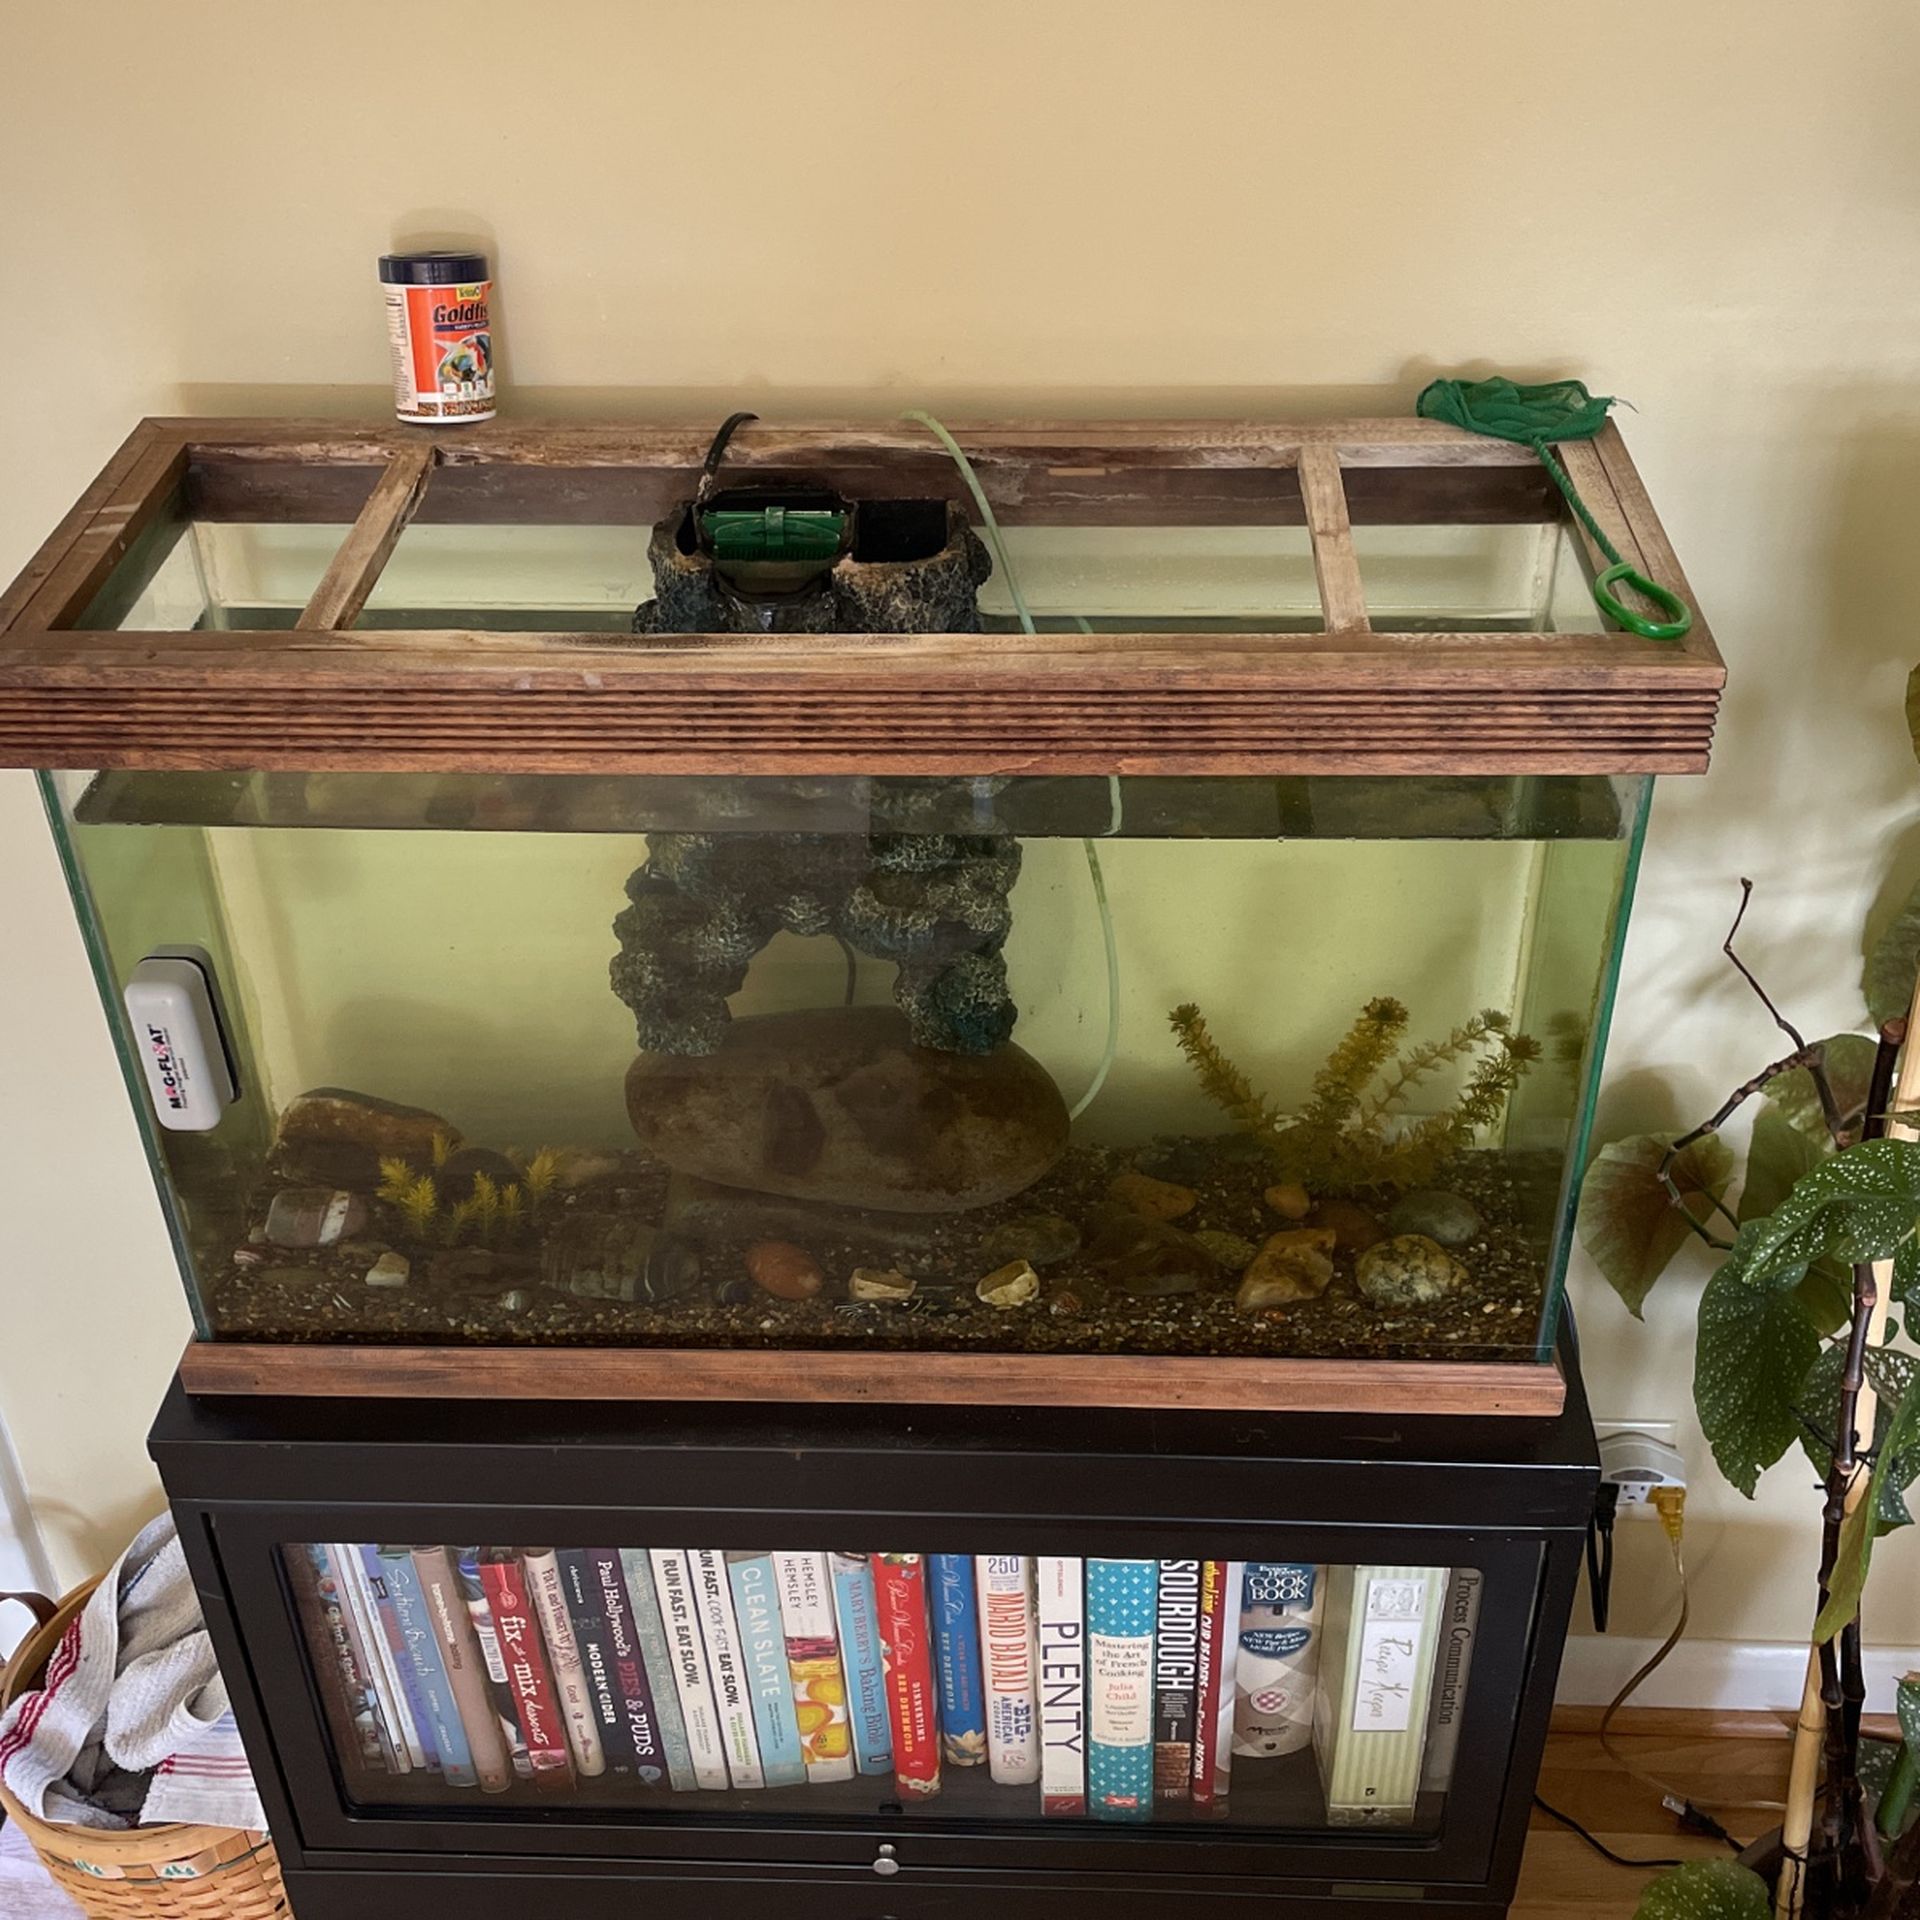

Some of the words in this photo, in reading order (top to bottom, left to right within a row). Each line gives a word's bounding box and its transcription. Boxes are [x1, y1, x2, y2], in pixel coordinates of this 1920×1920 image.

[598, 1561, 615, 1587] Paul
[662, 1559, 680, 1588] RUN
[699, 1549, 714, 1569] UN
[988, 1556, 1019, 1574] 250
[702, 1569, 719, 1599] FAST.
[783, 1559, 800, 1610] HEMSLEY
[801, 1557, 818, 1608] HEMSLEY
[848, 1581, 864, 1613] MARY
[1249, 1575, 1308, 1590] COOK
[1252, 1587, 1306, 1600] BOOK
[668, 1589, 687, 1622] FAST.
[707, 1598, 724, 1627] COOK
[742, 1566, 769, 1634] CLEAN
[986, 1591, 1026, 1639] MARIO
[1457, 1575, 1481, 1624] Process
[500, 1615, 527, 1644] fix
[603, 1588, 631, 1657] Hollywood's
[675, 1625, 691, 1648] EAT
[1156, 1559, 1197, 1689] SOURDOUGH
[1095, 1639, 1149, 1650] Mastering
[1102, 1650, 1120, 1659] the
[1123, 1651, 1140, 1659] Art
[514, 1662, 542, 1698] mix
[618, 1661, 641, 1697] PIES
[680, 1649, 700, 1688] SLOW.
[718, 1654, 732, 1673] EAT
[754, 1640, 780, 1698] SLATE
[989, 1641, 1029, 1693] BATALI
[1096, 1658, 1107, 1666] of
[1111, 1660, 1147, 1669] French
[1099, 1669, 1145, 1678] Cooking
[1438, 1627, 1472, 1726] Communication
[586, 1643, 607, 1690] MODERN
[599, 1693, 615, 1725] CIDER
[722, 1674, 739, 1707] SLOW.
[859, 1668, 881, 1713] Baking
[897, 1673, 907, 1692] REE
[942, 1655, 955, 1711] DRUMMOND
[1041, 1622, 1081, 1754] PLENTY
[1106, 1692, 1137, 1700] Child
[1108, 1683, 1134, 1691] Julia
[625, 1696, 643, 1711] &
[912, 1682, 925, 1742] DINNERTIME
[992, 1699, 1001, 1739] COOKBOOK
[1000, 1695, 1013, 1744] AMERICAN
[524, 1699, 550, 1746] desserts
[629, 1713, 653, 1756] PUDS
[866, 1714, 884, 1744] Bible
[899, 1697, 912, 1752] DRUMMOND
[1013, 1704, 1031, 1737] BIG
